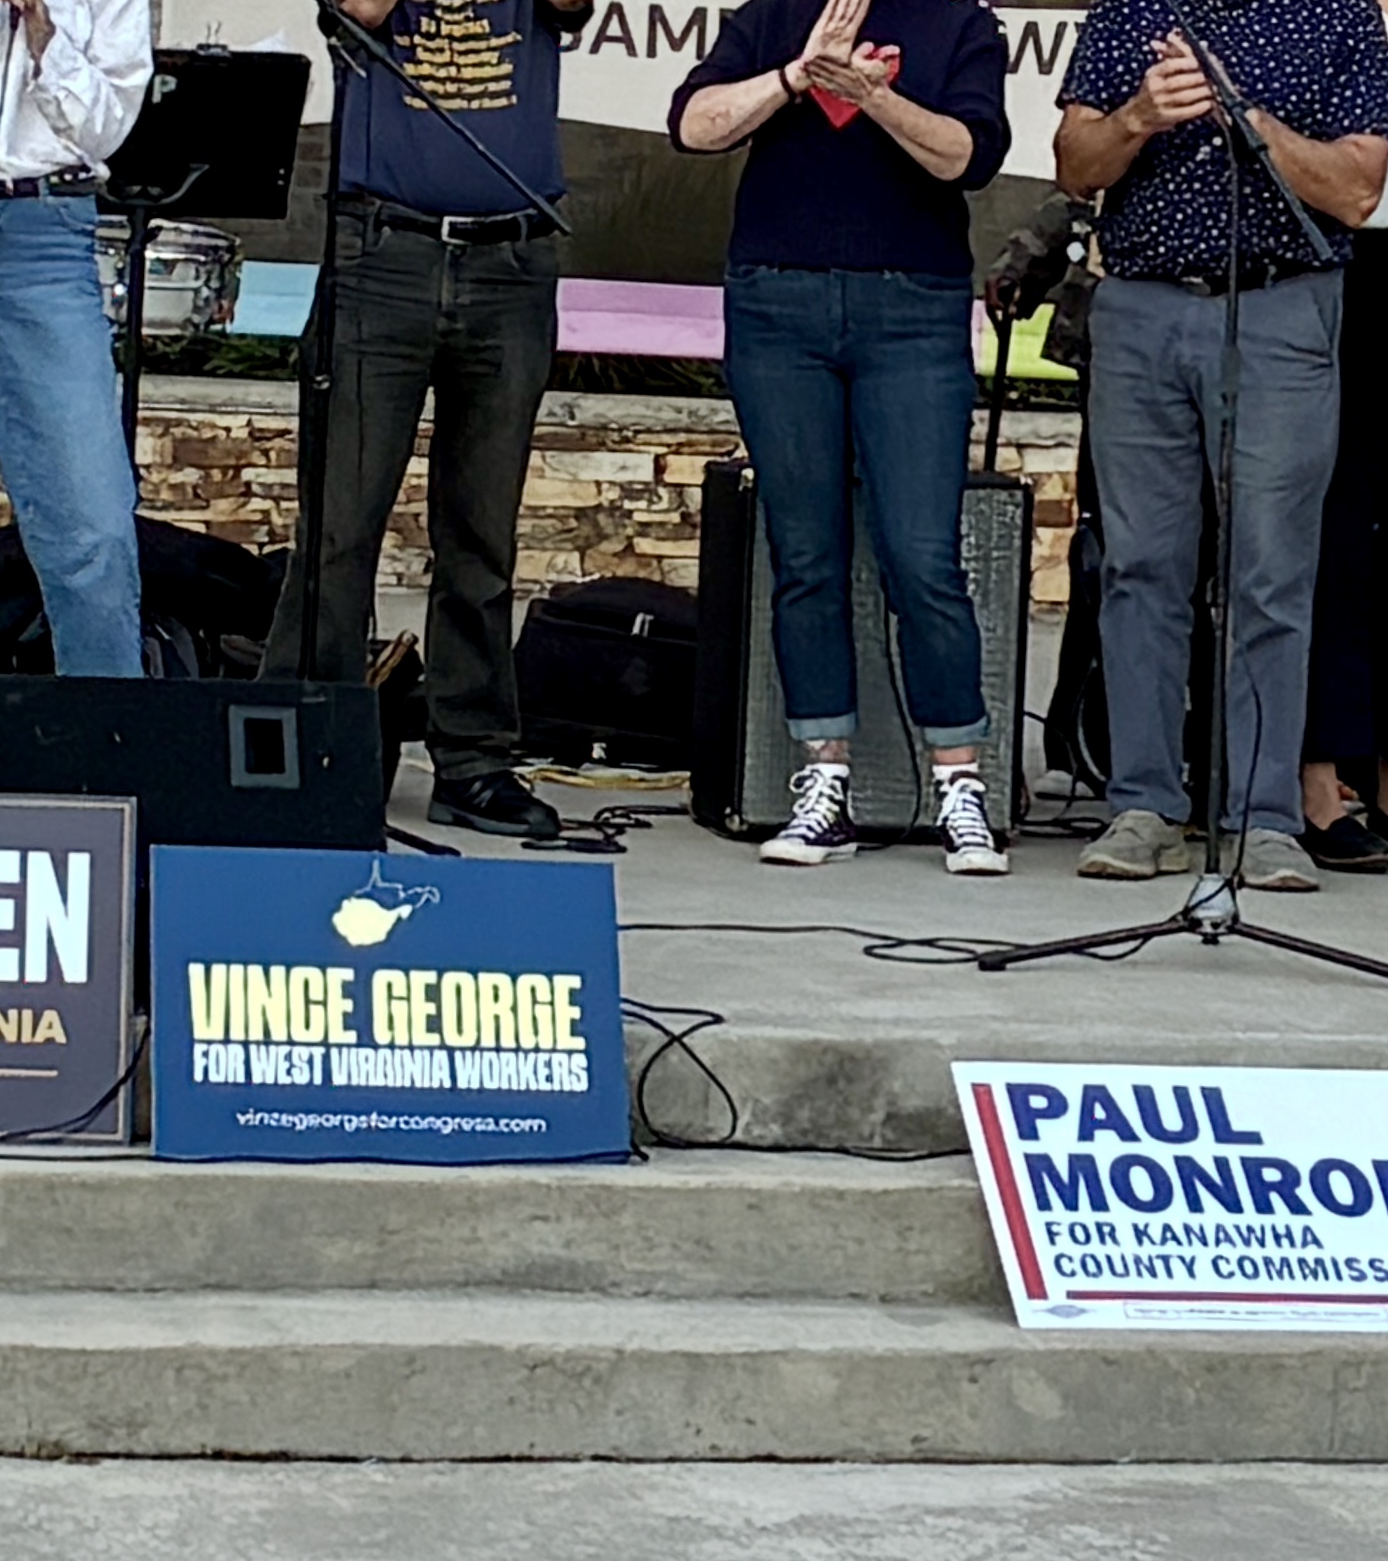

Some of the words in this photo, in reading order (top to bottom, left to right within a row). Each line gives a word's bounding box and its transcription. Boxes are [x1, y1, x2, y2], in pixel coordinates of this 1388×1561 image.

[188, 963, 357, 1044] VINCE
[371, 969, 586, 1050] GEORGE
[193, 1043, 245, 1084] FOR
[249, 1045, 325, 1085] WEST
[330, 1047, 451, 1088] VIRGINIA
[454, 1051, 589, 1092] WORKERS
[1005, 1082, 1264, 1145] PAUL
[1045, 1221, 1118, 1247] FOR
[1132, 1222, 1324, 1251] KANAWHA
[1053, 1253, 1198, 1280] COUNTY
